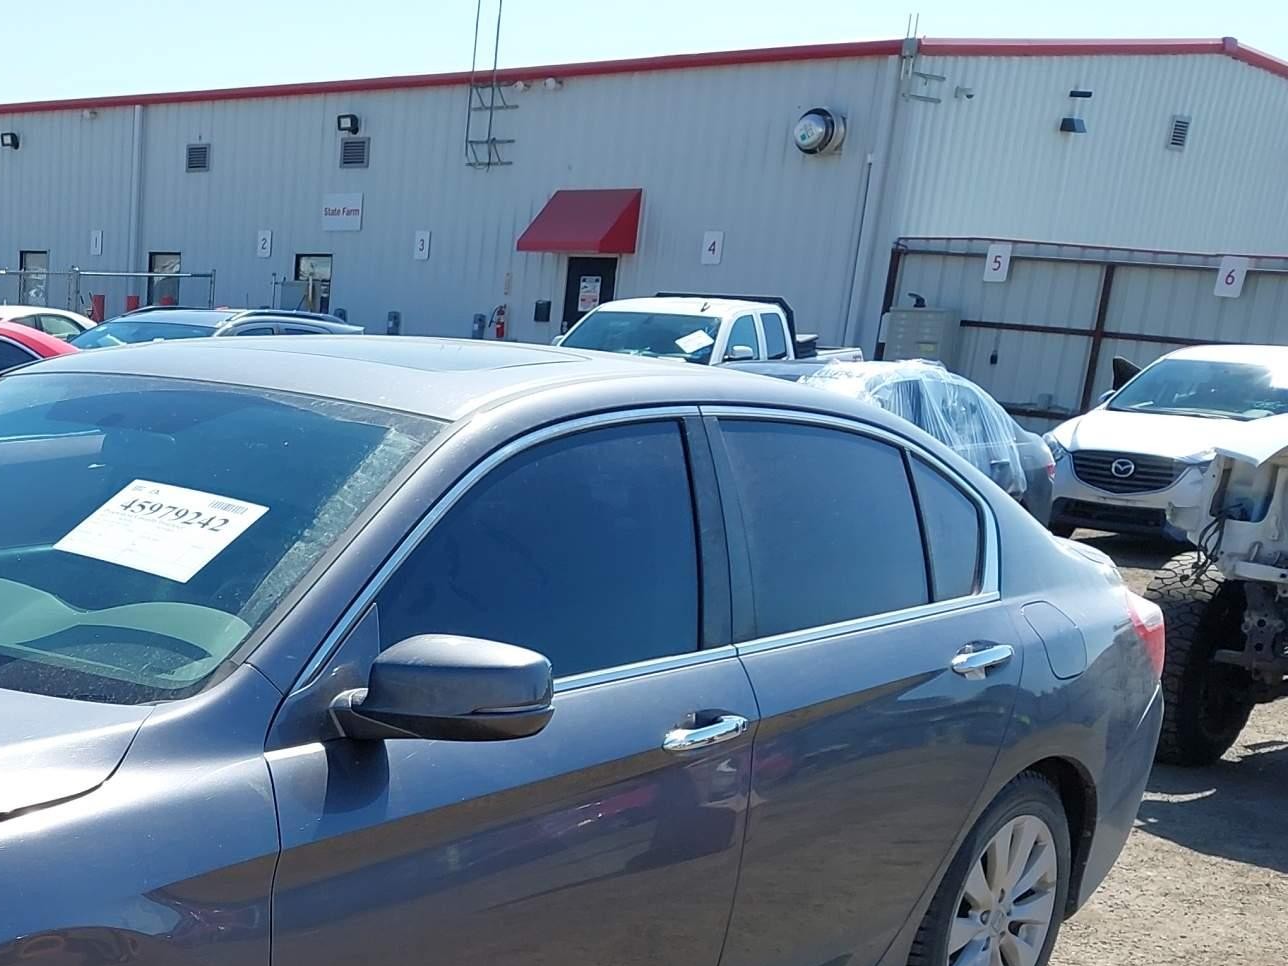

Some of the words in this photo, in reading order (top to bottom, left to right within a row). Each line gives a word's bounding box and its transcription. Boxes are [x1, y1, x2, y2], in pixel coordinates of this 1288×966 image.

[324, 207, 341, 217] State
[342, 207, 360, 217] Farm
[261, 237, 267, 250] 2
[418, 238, 425, 252] 3
[708, 240, 716, 255] 4
[991, 255, 1002, 271] 5
[1224, 268, 1236, 285] 6
[119, 498, 230, 532] 45979242
